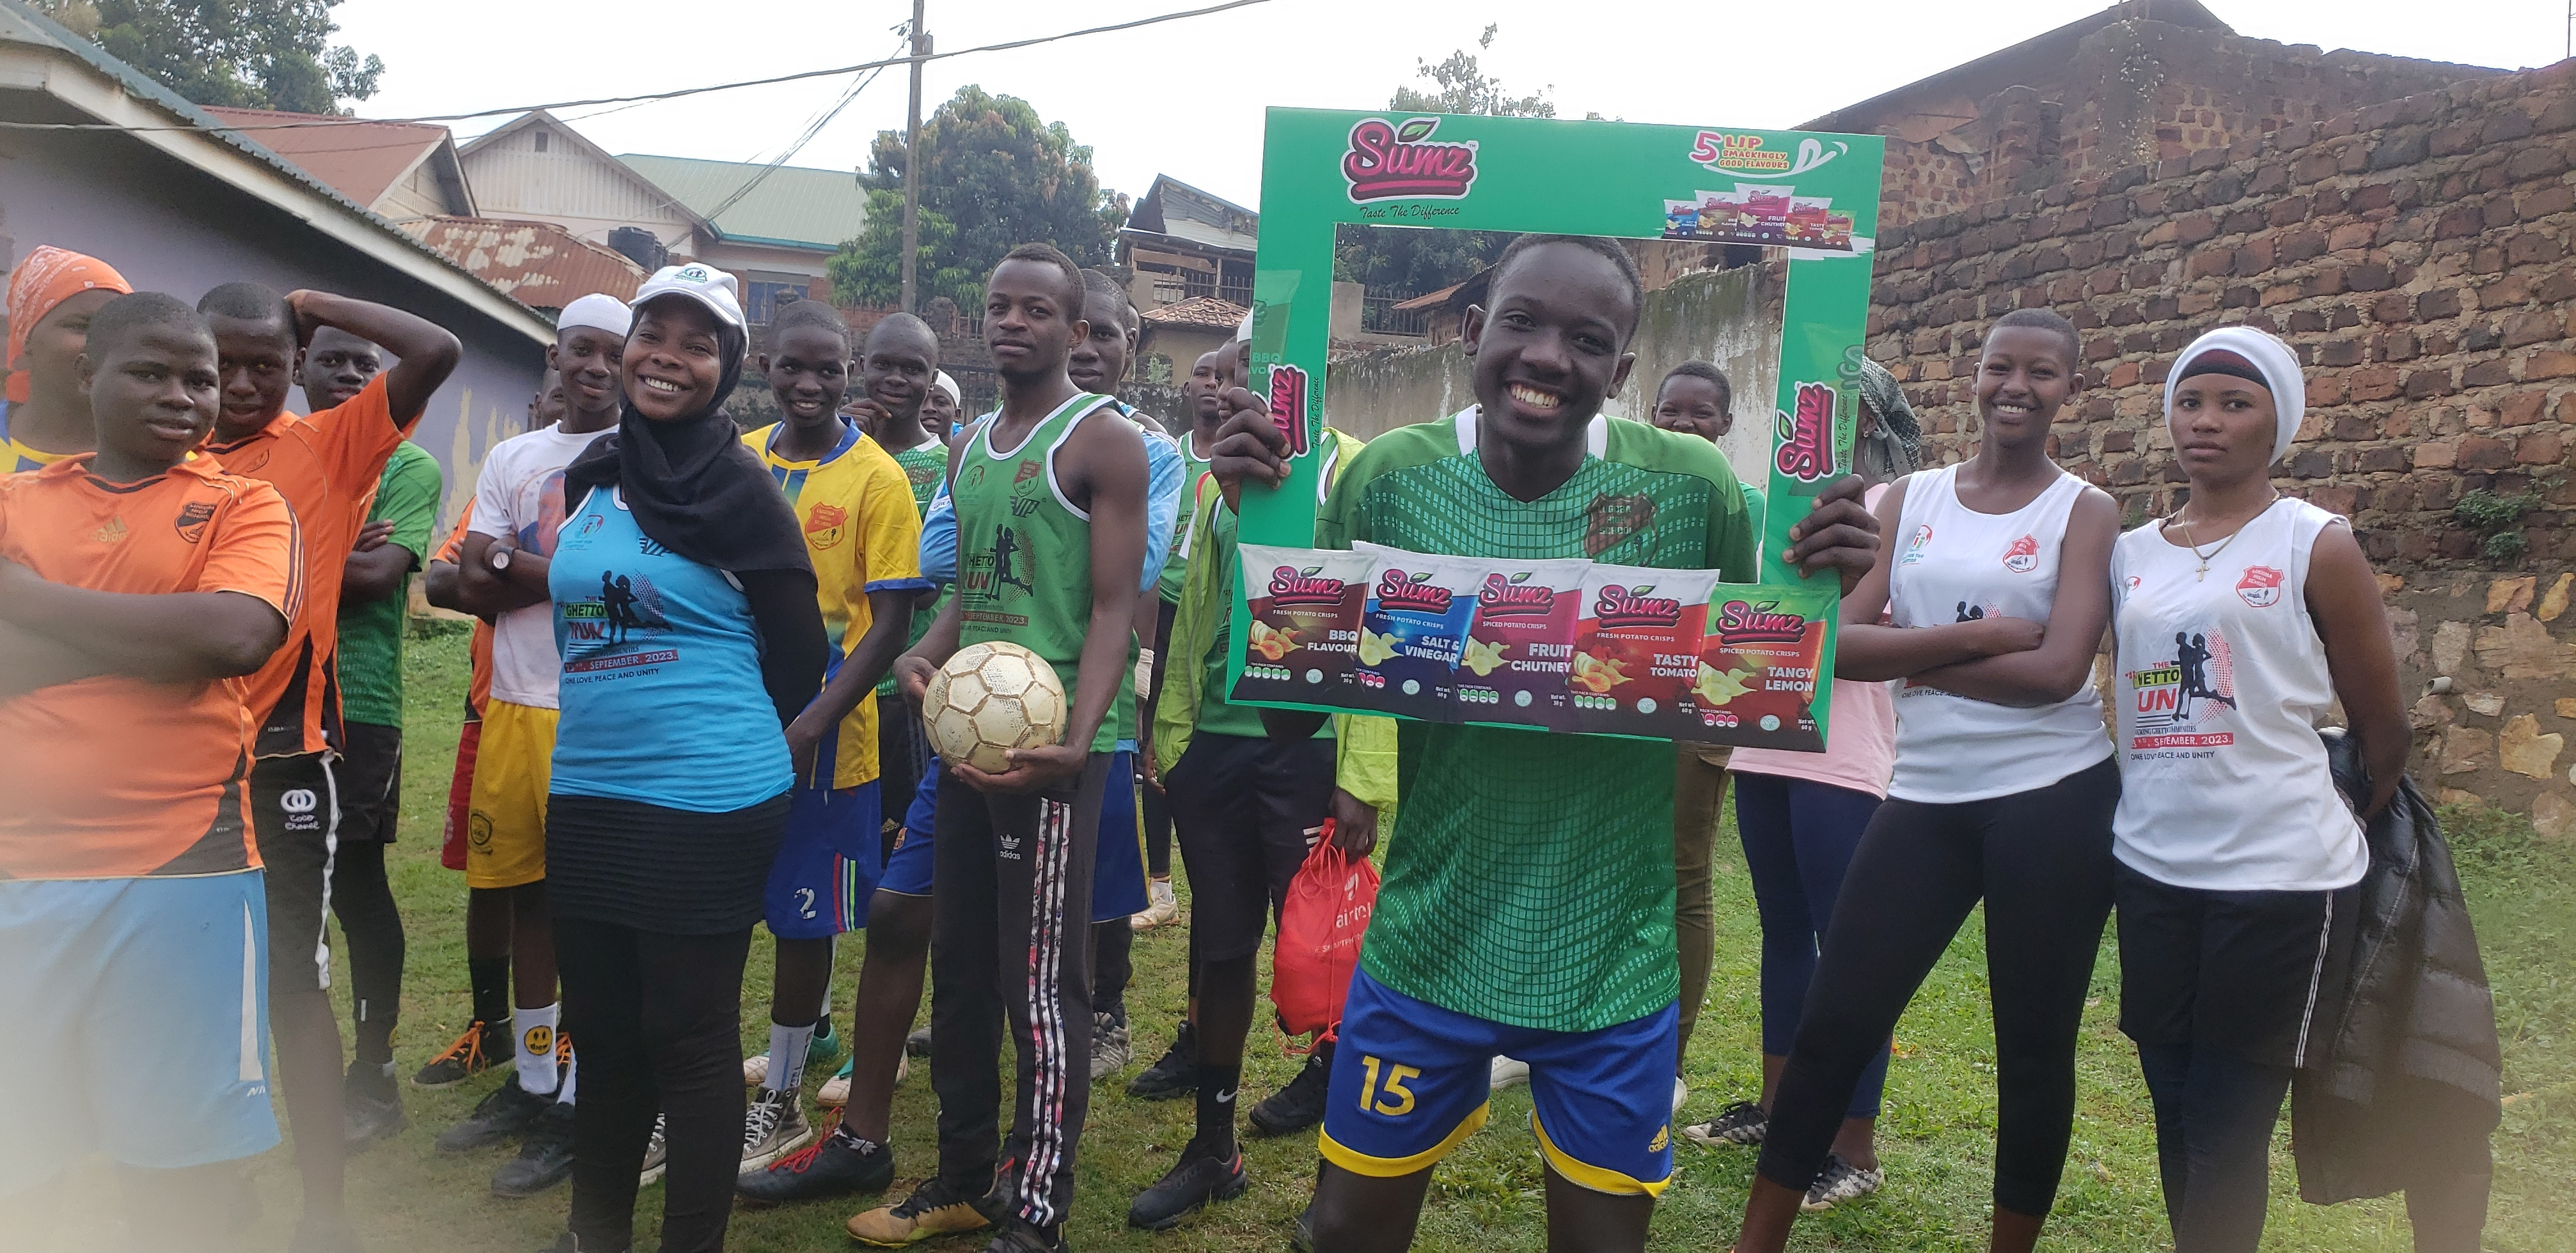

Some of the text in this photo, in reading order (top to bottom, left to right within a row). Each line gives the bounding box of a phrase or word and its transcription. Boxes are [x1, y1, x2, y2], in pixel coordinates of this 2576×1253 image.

[1346, 120, 1472, 178] Sumz
[1689, 130, 1763, 163] 5 LIP
[1722, 150, 1787, 160] SMACKINGLY
[1719, 159, 1789, 169] GOOD FLAVOURS
[1359, 204, 1459, 220] Taste The Difference
[1252, 353, 1281, 363] BBQ
[1311, 377, 1320, 449] Taste The Difference
[1778, 385, 1822, 478] Sumz
[1837, 394, 1848, 468] Taste The Difference
[967, 571, 992, 589] UN
[1270, 565, 1344, 595] Sumz
[1378, 568, 1452, 605] Sumz
[1480, 573, 1554, 604] Sumz
[1596, 584, 1681, 616] Sumz
[566, 604, 604, 616] GHETTO
[1718, 600, 1805, 632] Sumz
[1397, 617, 1421, 625] POTATO
[1422, 621, 1444, 630] CRISPS
[1329, 630, 1358, 641] BBQ
[1307, 642, 1357, 653] FLAVOUR
[1421, 635, 1459, 651] SALT &
[1529, 642, 1573, 657] FRUIT
[645, 651, 677, 662] 2023.
[1405, 645, 1458, 663] VINEGAR
[1654, 653, 1699, 667] TASTY
[1511, 660, 1572, 673] CHUTNEY
[1767, 666, 1814, 678] TANGY
[2153, 661, 2169, 669] THE
[595, 674, 616, 682] PEACE
[618, 670, 634, 679] AND
[637, 668, 659, 676] UNITY
[1651, 667, 1697, 678] TOMATO
[2138, 669, 2179, 686] HETTO
[1765, 680, 1813, 692] LEMON
[2138, 687, 2177, 712] UN
[2201, 735, 2231, 744] 2023.
[2130, 752, 2143, 760] ONE
[2192, 751, 2215, 759] UNITY
[285, 821, 320, 830] Chanel
[1000, 850, 1021, 860] adidas
[794, 887, 817, 919] 2
[1360, 1055, 1421, 1116] 15
